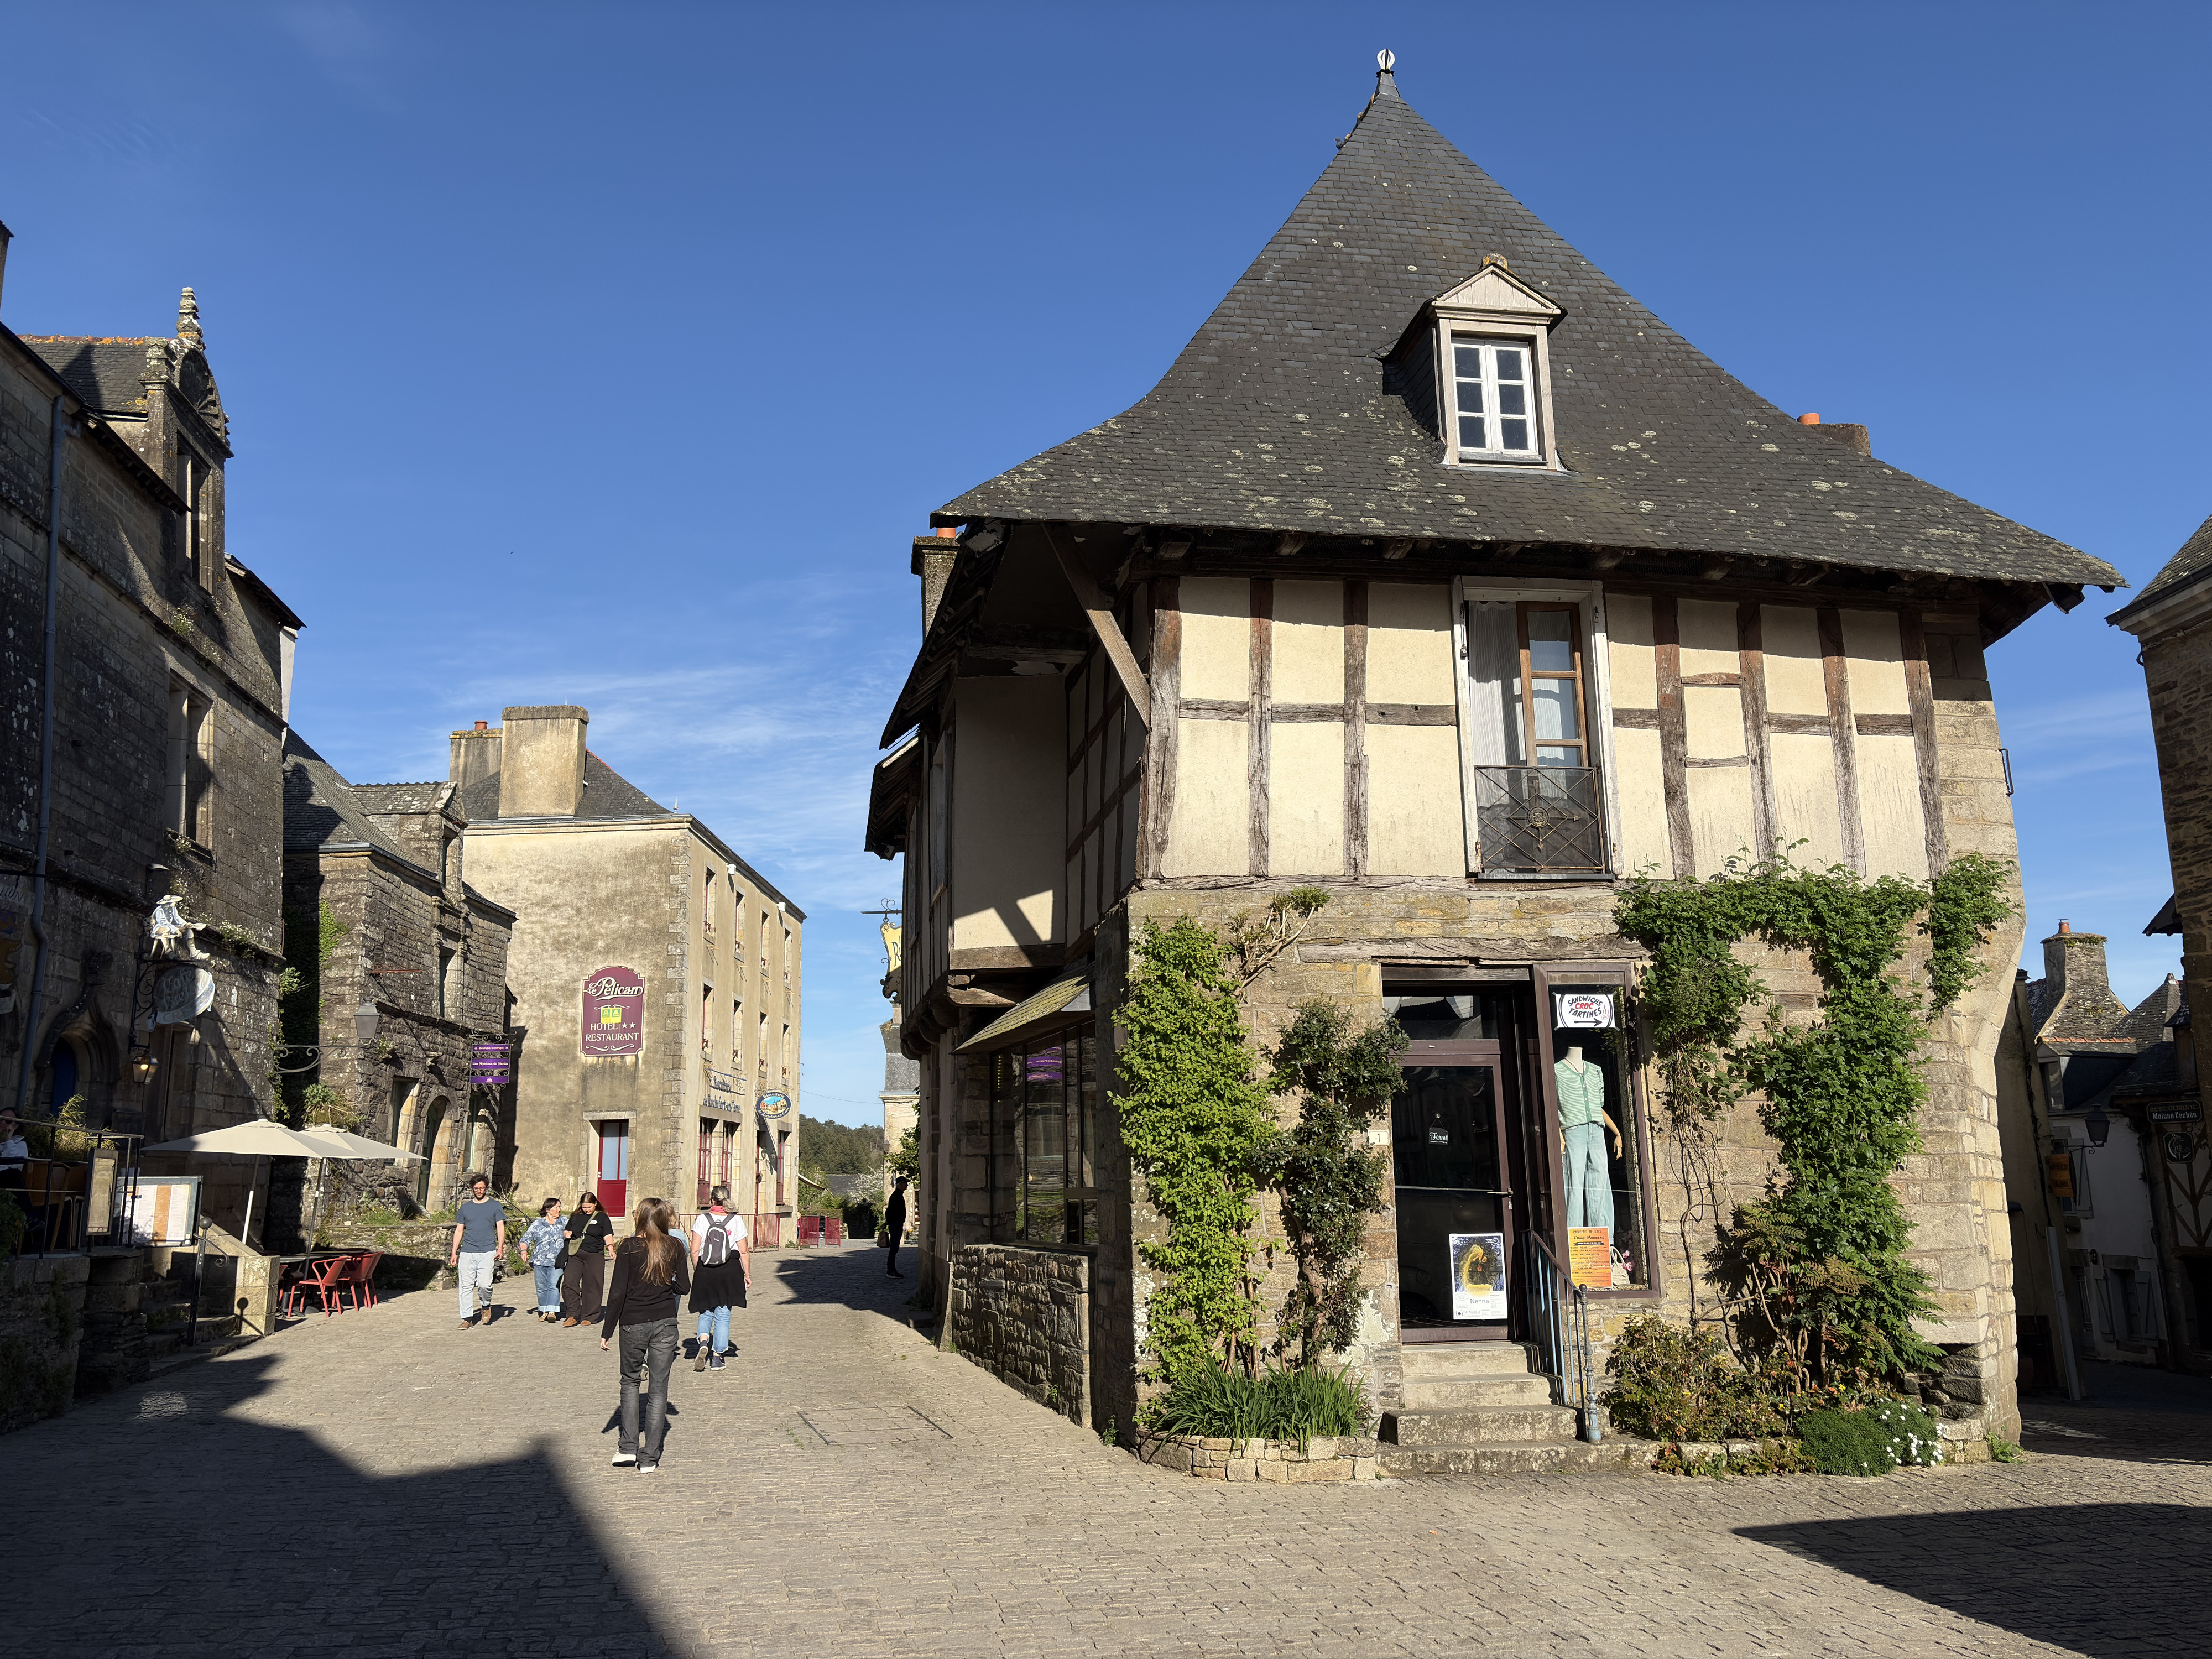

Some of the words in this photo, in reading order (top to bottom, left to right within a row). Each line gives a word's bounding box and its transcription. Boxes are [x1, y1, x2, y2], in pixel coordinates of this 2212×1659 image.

[584, 982, 597, 995] Le
[1568, 995, 1603, 1006] SANDWICHS
[1568, 1007, 1602, 1018] TARTINES
[585, 1032, 640, 1042] RESTAURANT
[2175, 1110, 2197, 1119] Cachée
[1377, 1133, 1380, 1142] 1
[1429, 1131, 1448, 1141] Fermé
